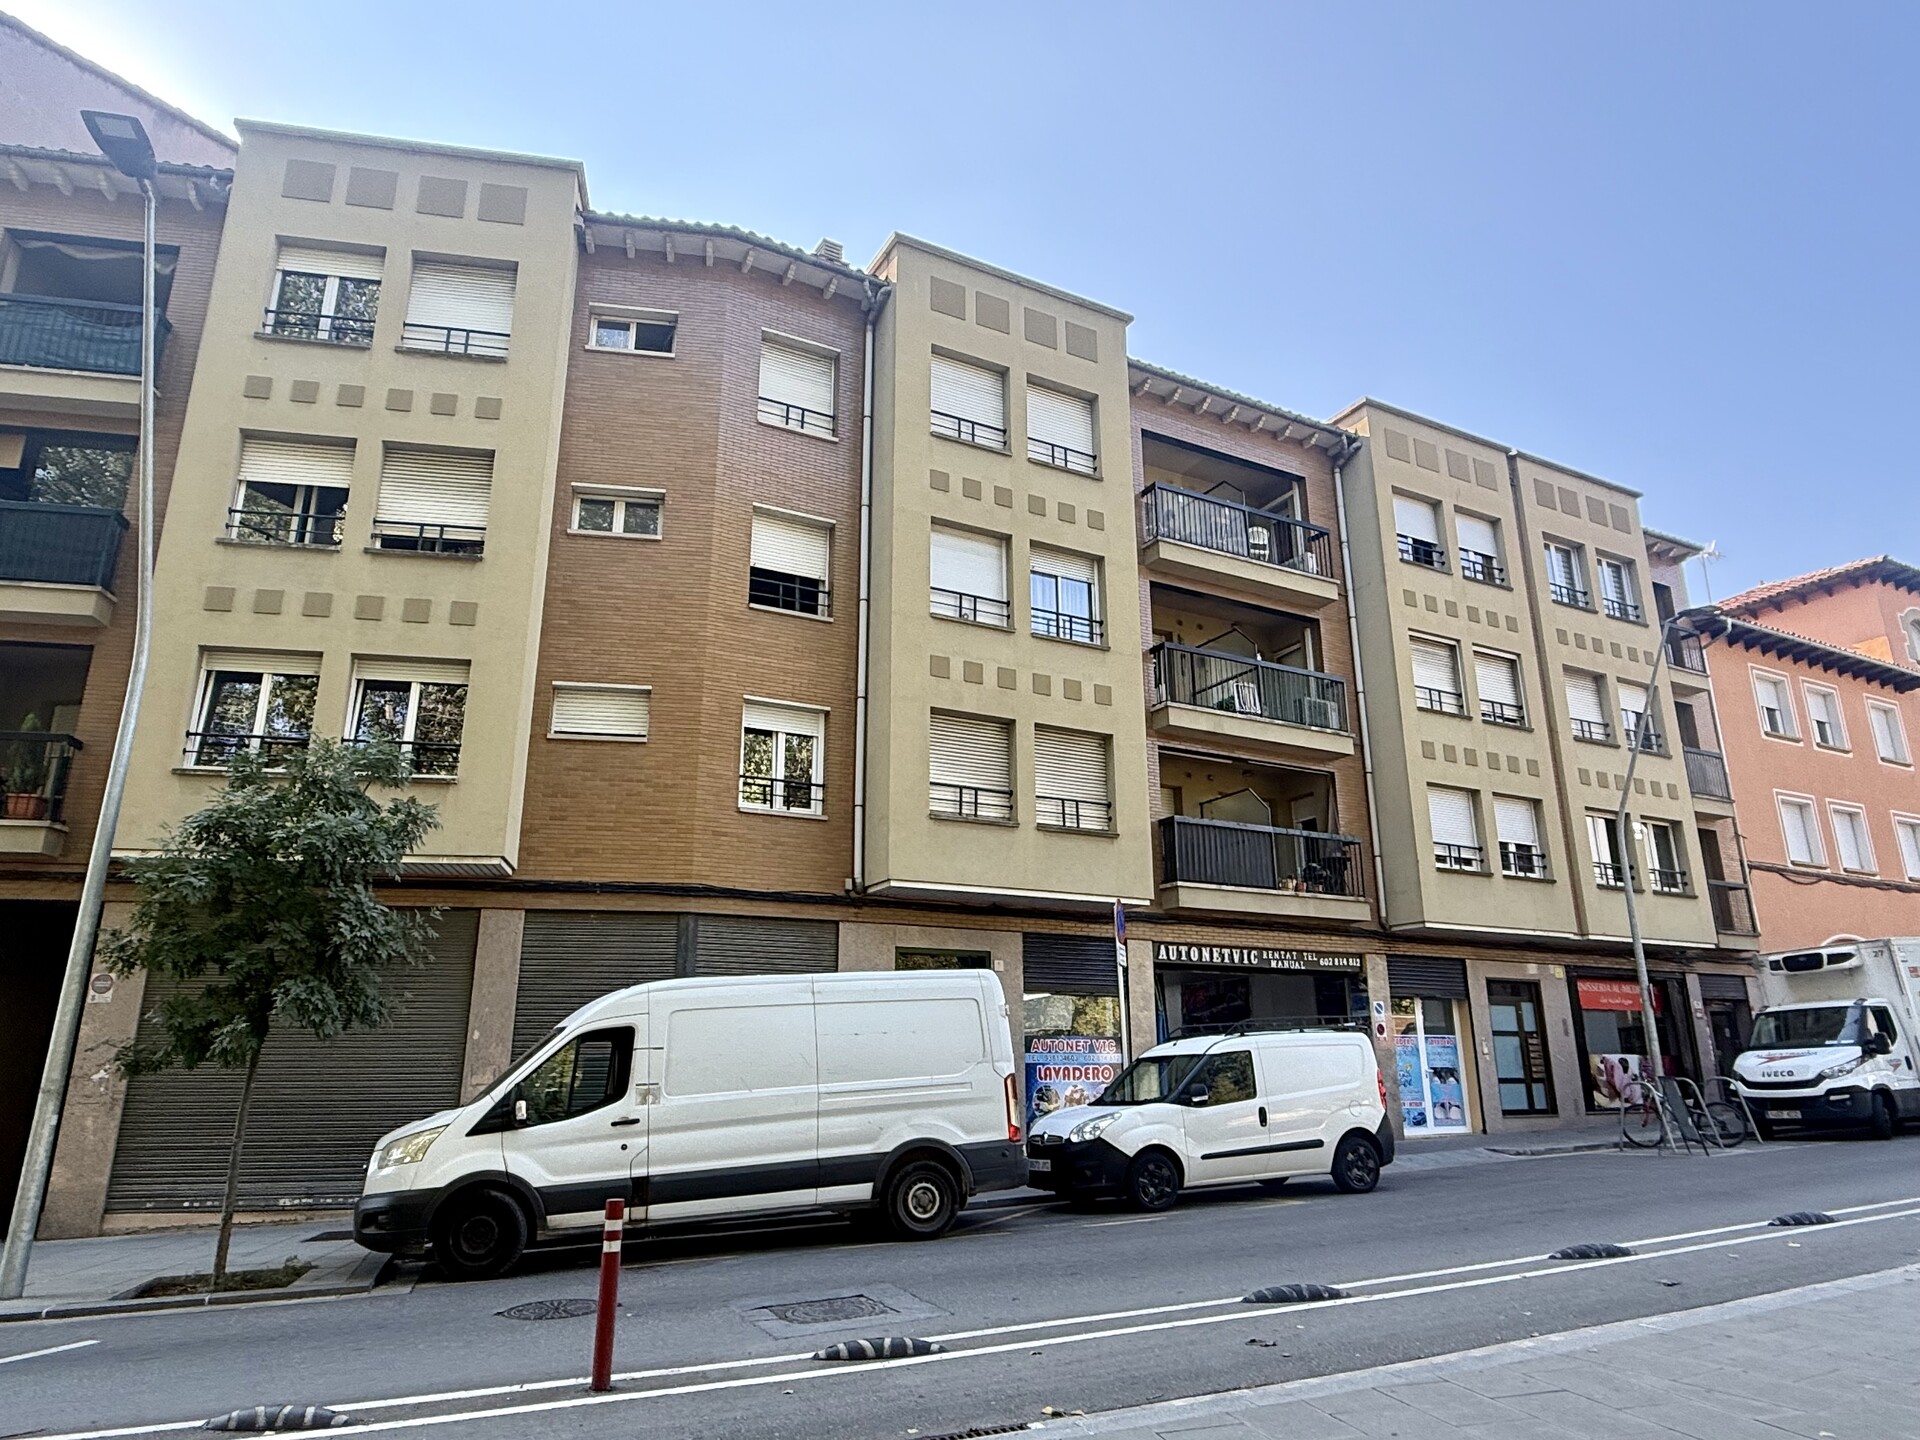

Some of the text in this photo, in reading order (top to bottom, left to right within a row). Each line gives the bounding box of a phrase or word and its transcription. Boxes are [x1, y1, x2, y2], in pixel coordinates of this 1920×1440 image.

[1158, 944, 1258, 965] AUTONETVIC
[1262, 950, 1318, 961] RENTAT TEL
[1872, 949, 1884, 958] 27
[1270, 959, 1306, 969] MANUAL
[1319, 957, 1361, 967] 602 814 812
[1031, 1038, 1117, 1054] AUTONET VIC
[1037, 1064, 1114, 1082] LAVADERO
[1761, 1070, 1795, 1078] IVECO
